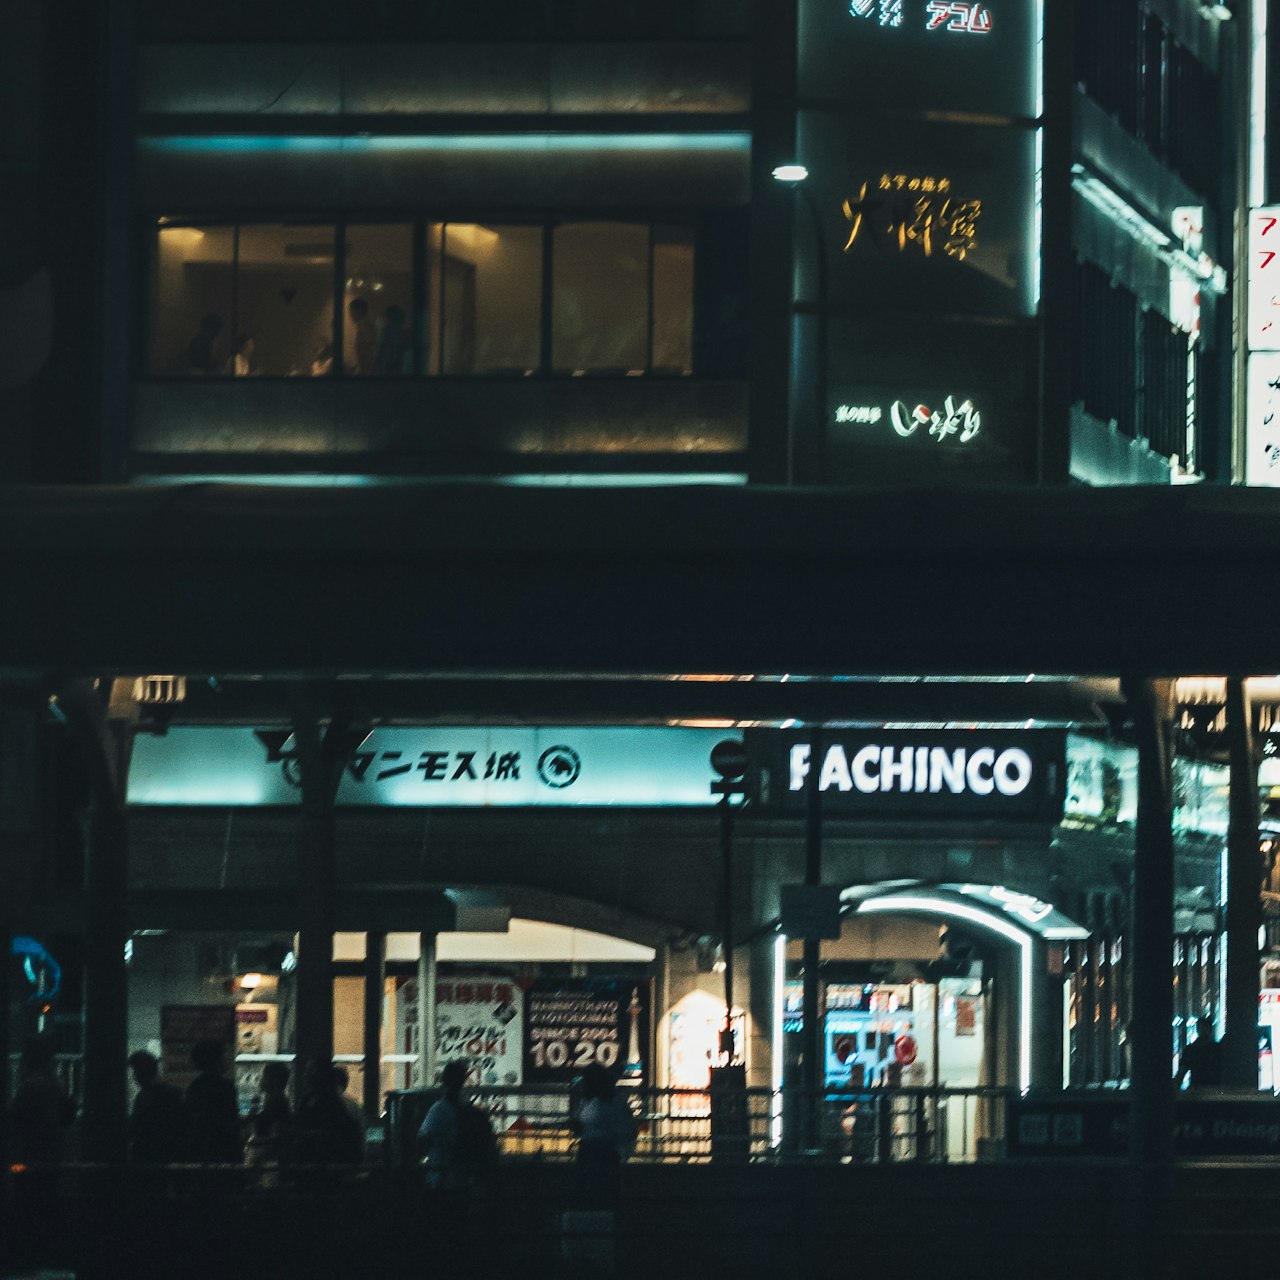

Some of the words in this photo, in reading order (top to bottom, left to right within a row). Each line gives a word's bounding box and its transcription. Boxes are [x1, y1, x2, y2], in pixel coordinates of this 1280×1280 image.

[926, 0, 992, 34] アコム
[530, 1039, 620, 1068] 10.20
